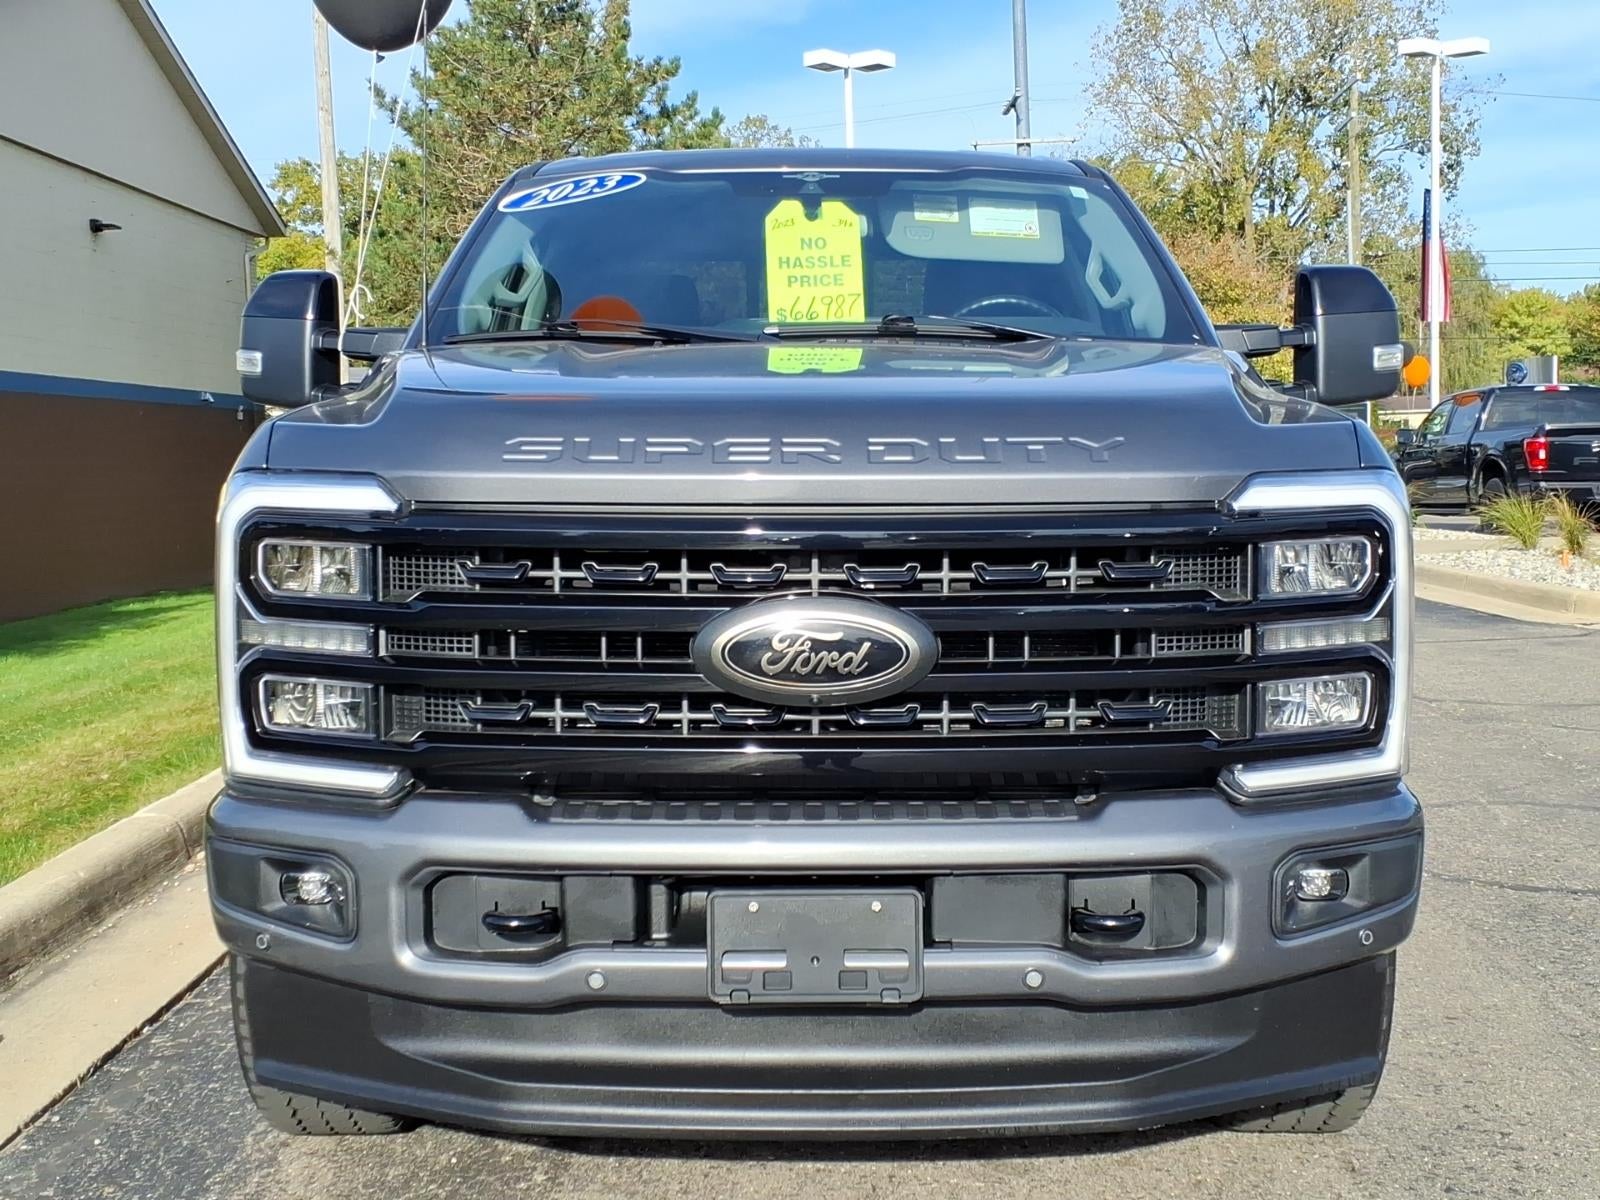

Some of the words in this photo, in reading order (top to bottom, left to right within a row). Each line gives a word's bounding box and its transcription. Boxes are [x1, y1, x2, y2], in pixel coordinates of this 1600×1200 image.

[520, 174, 622, 208] 2023
[800, 236, 827, 251] NO
[778, 254, 852, 270] HASSLE
[787, 272, 845, 288] PRICE
[502, 436, 842, 464] SUPER
[867, 436, 1126, 464] DUTY
[760, 628, 873, 676] Ford
